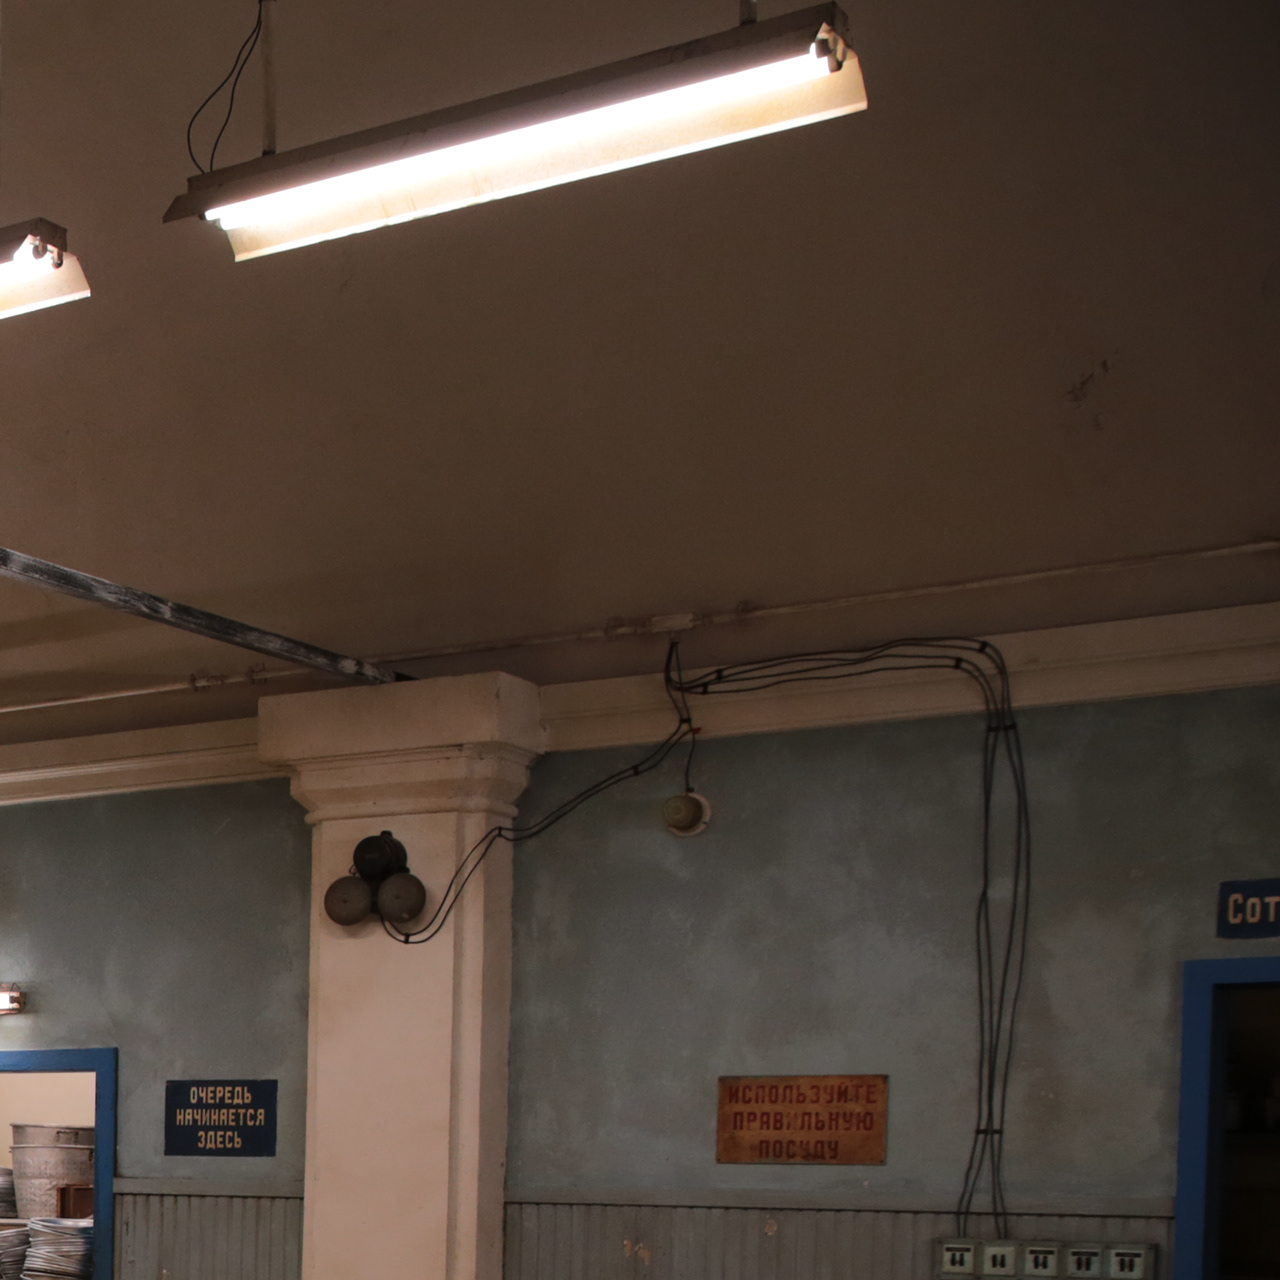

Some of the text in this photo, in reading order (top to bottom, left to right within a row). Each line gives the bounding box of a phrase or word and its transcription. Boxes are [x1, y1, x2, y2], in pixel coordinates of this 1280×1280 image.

[189, 1086, 252, 1105] ОЧЕРЕДЬ
[727, 1081, 878, 1105] ИСПОЛЬЗУЙТЕ
[175, 1108, 266, 1126] НАЧИНАЕТСЯ
[197, 1130, 243, 1150] ЗДЕСЬ
[758, 1139, 840, 1160] ПОСУДУ
